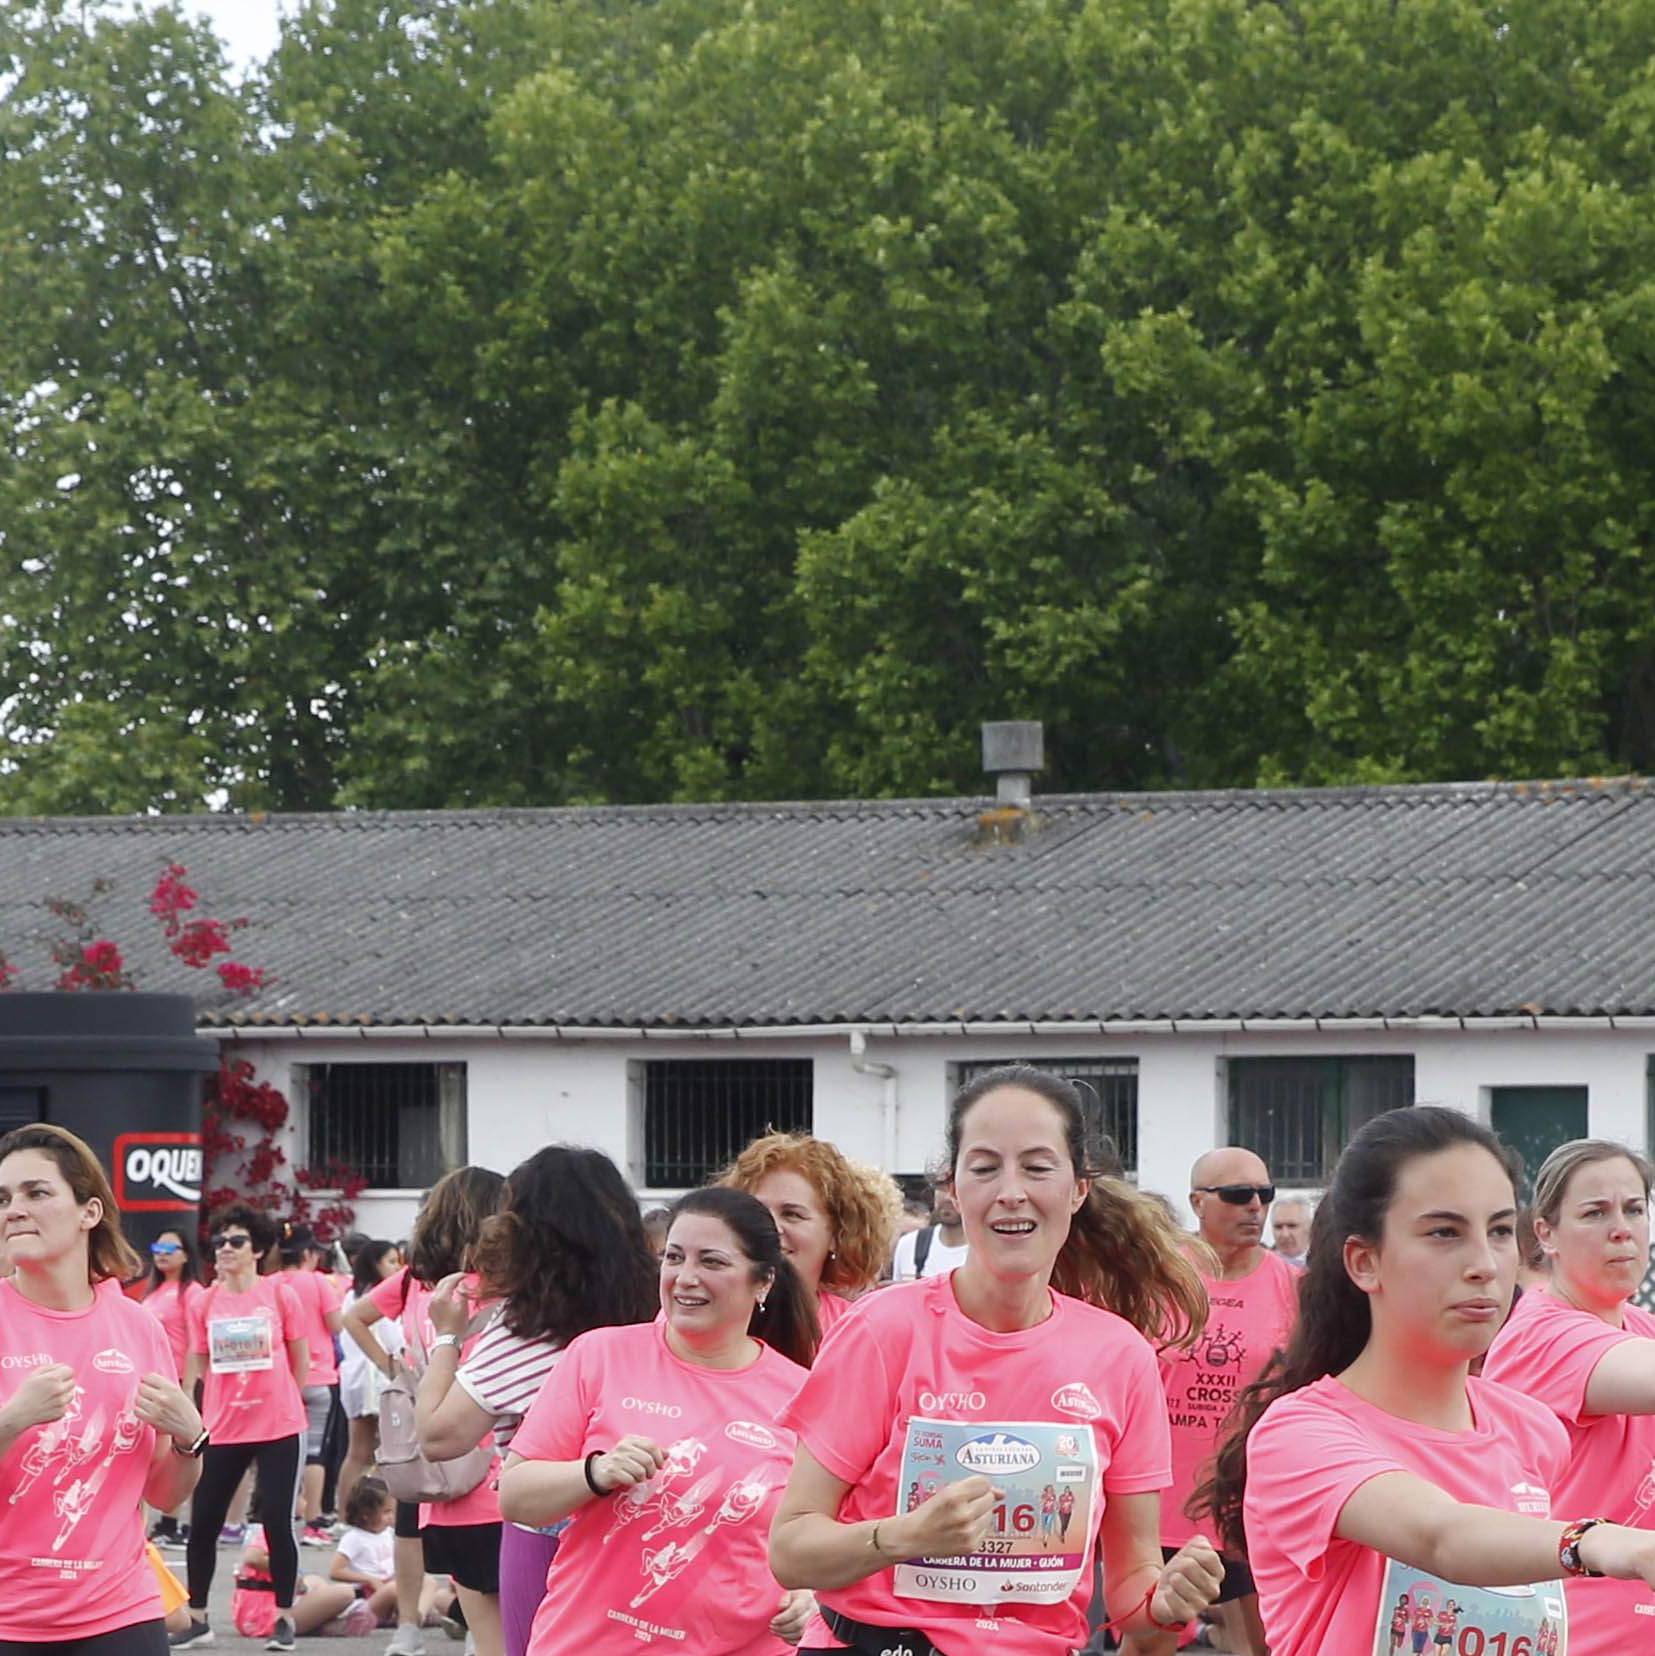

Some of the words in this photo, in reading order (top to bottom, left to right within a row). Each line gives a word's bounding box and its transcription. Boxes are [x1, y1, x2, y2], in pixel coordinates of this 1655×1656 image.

[1196, 1373, 1236, 1387] XXXII
[621, 1396, 682, 1419] OYSHO
[919, 1391, 987, 1412] OYSHO
[914, 1438, 943, 1449] SUMA
[962, 1449, 1035, 1465] ASTURIANA
[969, 1557, 984, 1568] DE
[985, 1558, 997, 1568] LA
[999, 1557, 1032, 1569] MUJER
[915, 1573, 977, 1592] OYSHO
[1015, 1582, 1068, 1593] Santander
